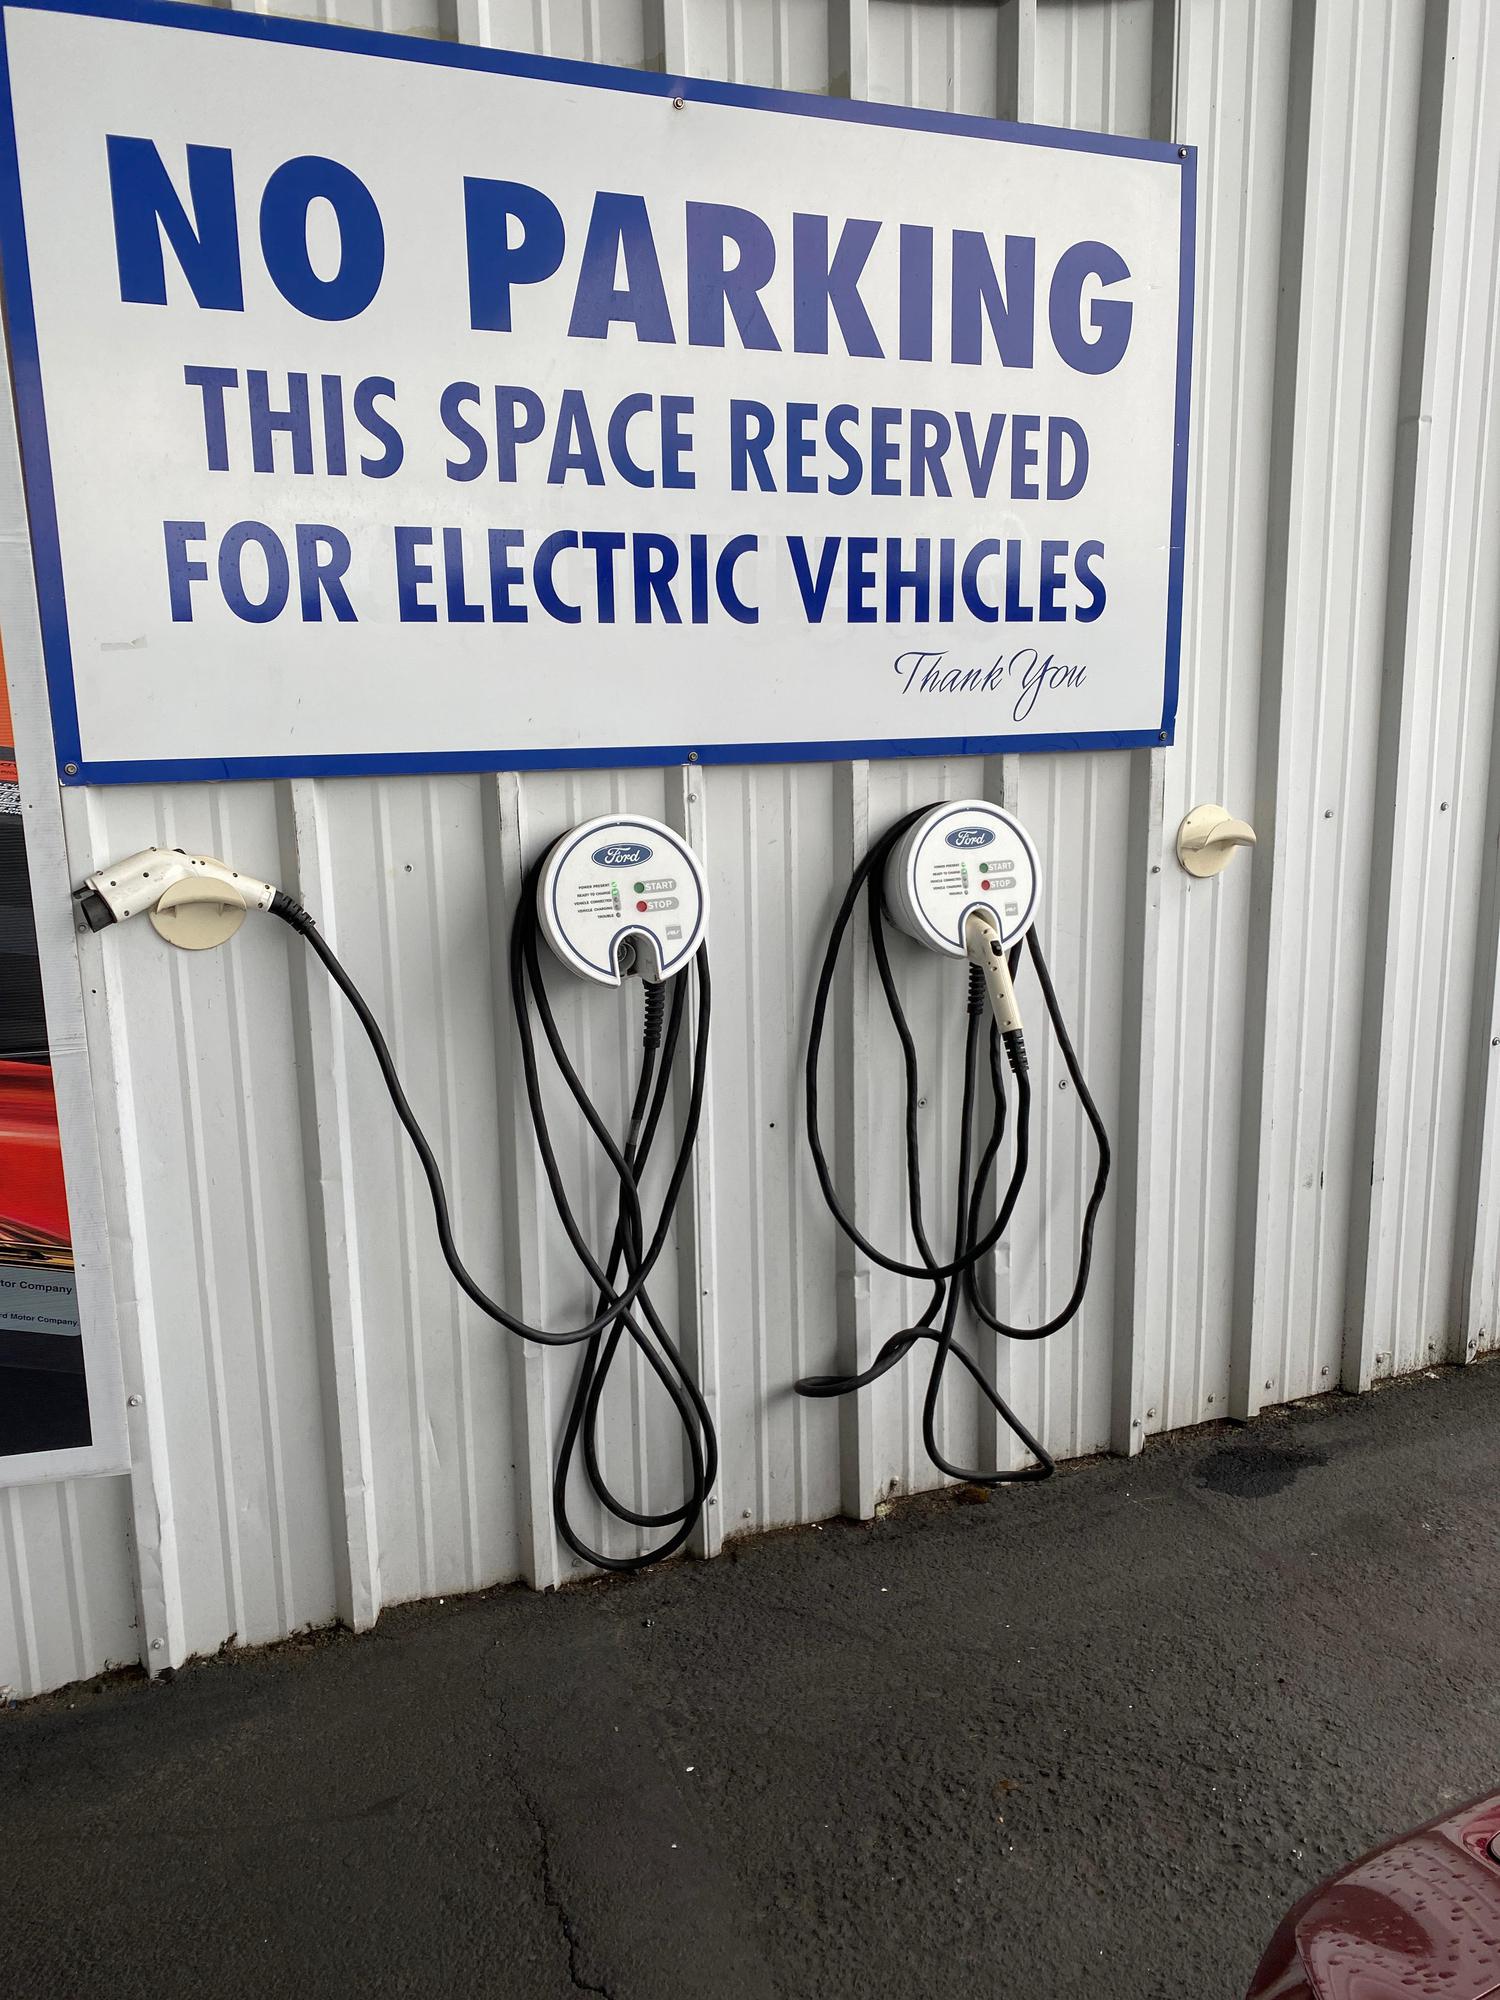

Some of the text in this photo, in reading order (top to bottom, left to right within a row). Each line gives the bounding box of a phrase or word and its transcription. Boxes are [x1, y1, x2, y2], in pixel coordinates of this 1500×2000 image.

[107, 134, 1132, 373] NO PARKING
[186, 367, 1089, 501] THIS SPACE RESERVED
[166, 520, 1107, 625] FOR ELECTRIC VEHICLES
[894, 648, 1086, 722] Thank You
[955, 831, 986, 846] Ford
[604, 847, 641, 864] Ford
[988, 862, 1012, 871] START
[645, 881, 673, 891] START
[991, 879, 1010, 888] STOP
[648, 900, 673, 909] STOP
[20, 1281, 73, 1295] Company
[10, 1313, 35, 1321] Motor
